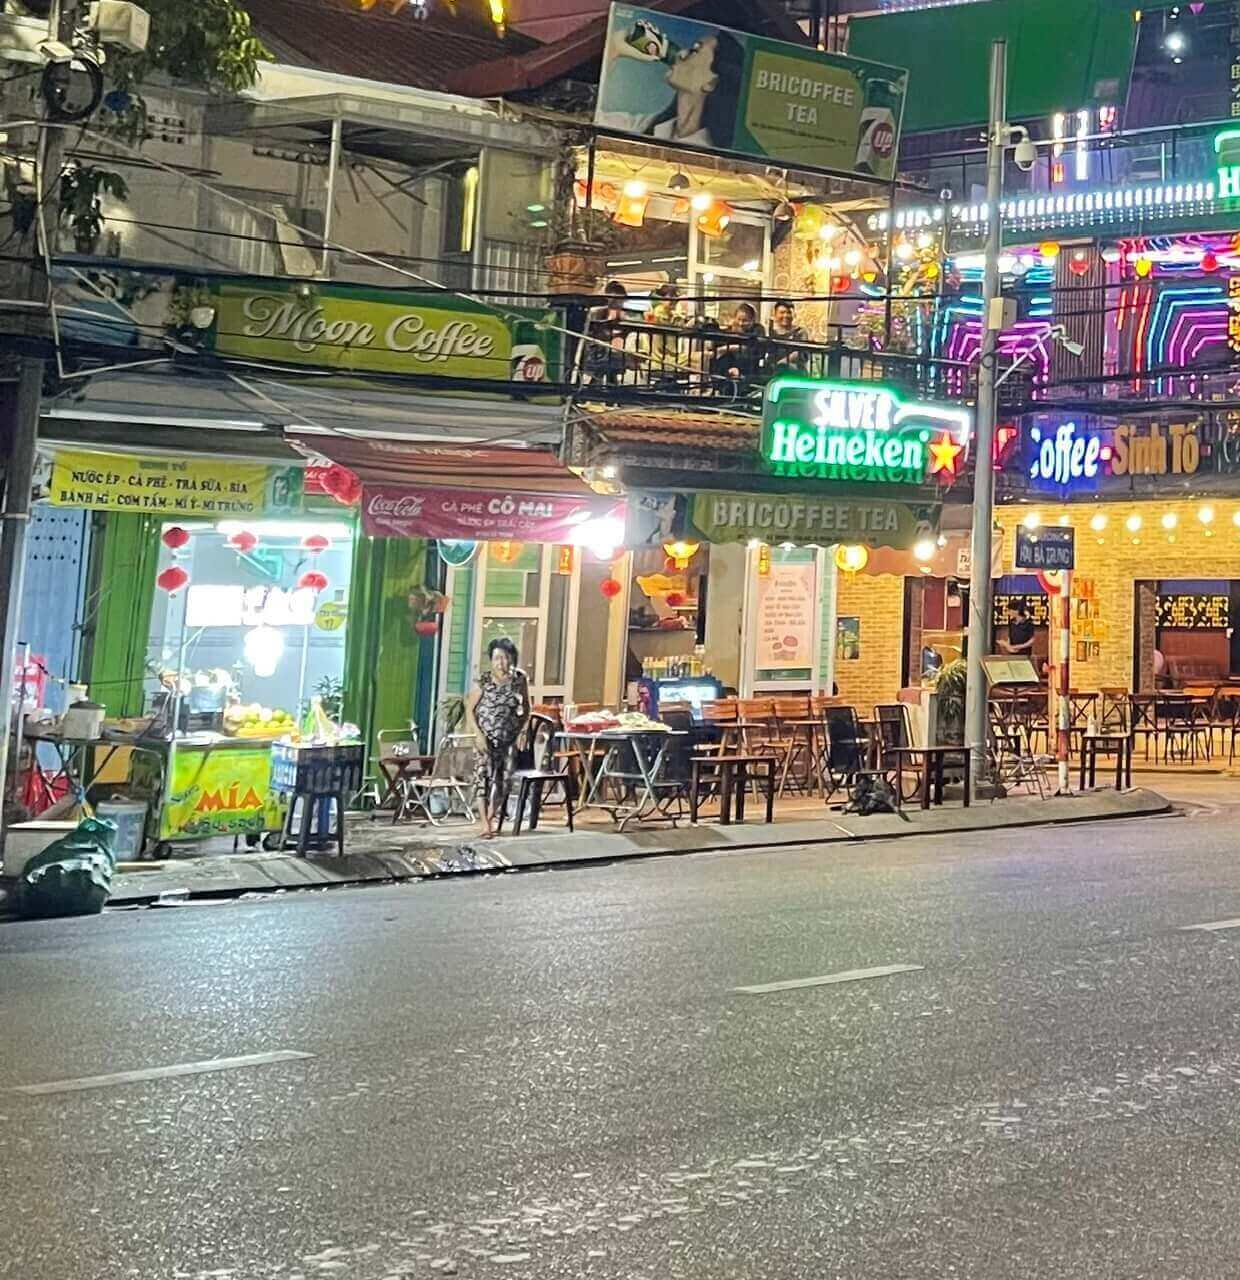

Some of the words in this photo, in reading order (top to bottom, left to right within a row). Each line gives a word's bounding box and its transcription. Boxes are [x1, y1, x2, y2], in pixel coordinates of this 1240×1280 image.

[755, 69, 855, 106] BRICOFFEE
[787, 102, 818, 125] TEA
[243, 296, 375, 352] Moon
[385, 314, 496, 362] Coffee
[814, 390, 891, 430] SILVER
[770, 421, 923, 469] Heineken
[488, 495, 515, 515] CÔ
[518, 501, 553, 517] MAI
[711, 501, 850, 532] BRICOFFEE
[857, 508, 899, 532] TEA
[194, 781, 263, 813] MÍA
